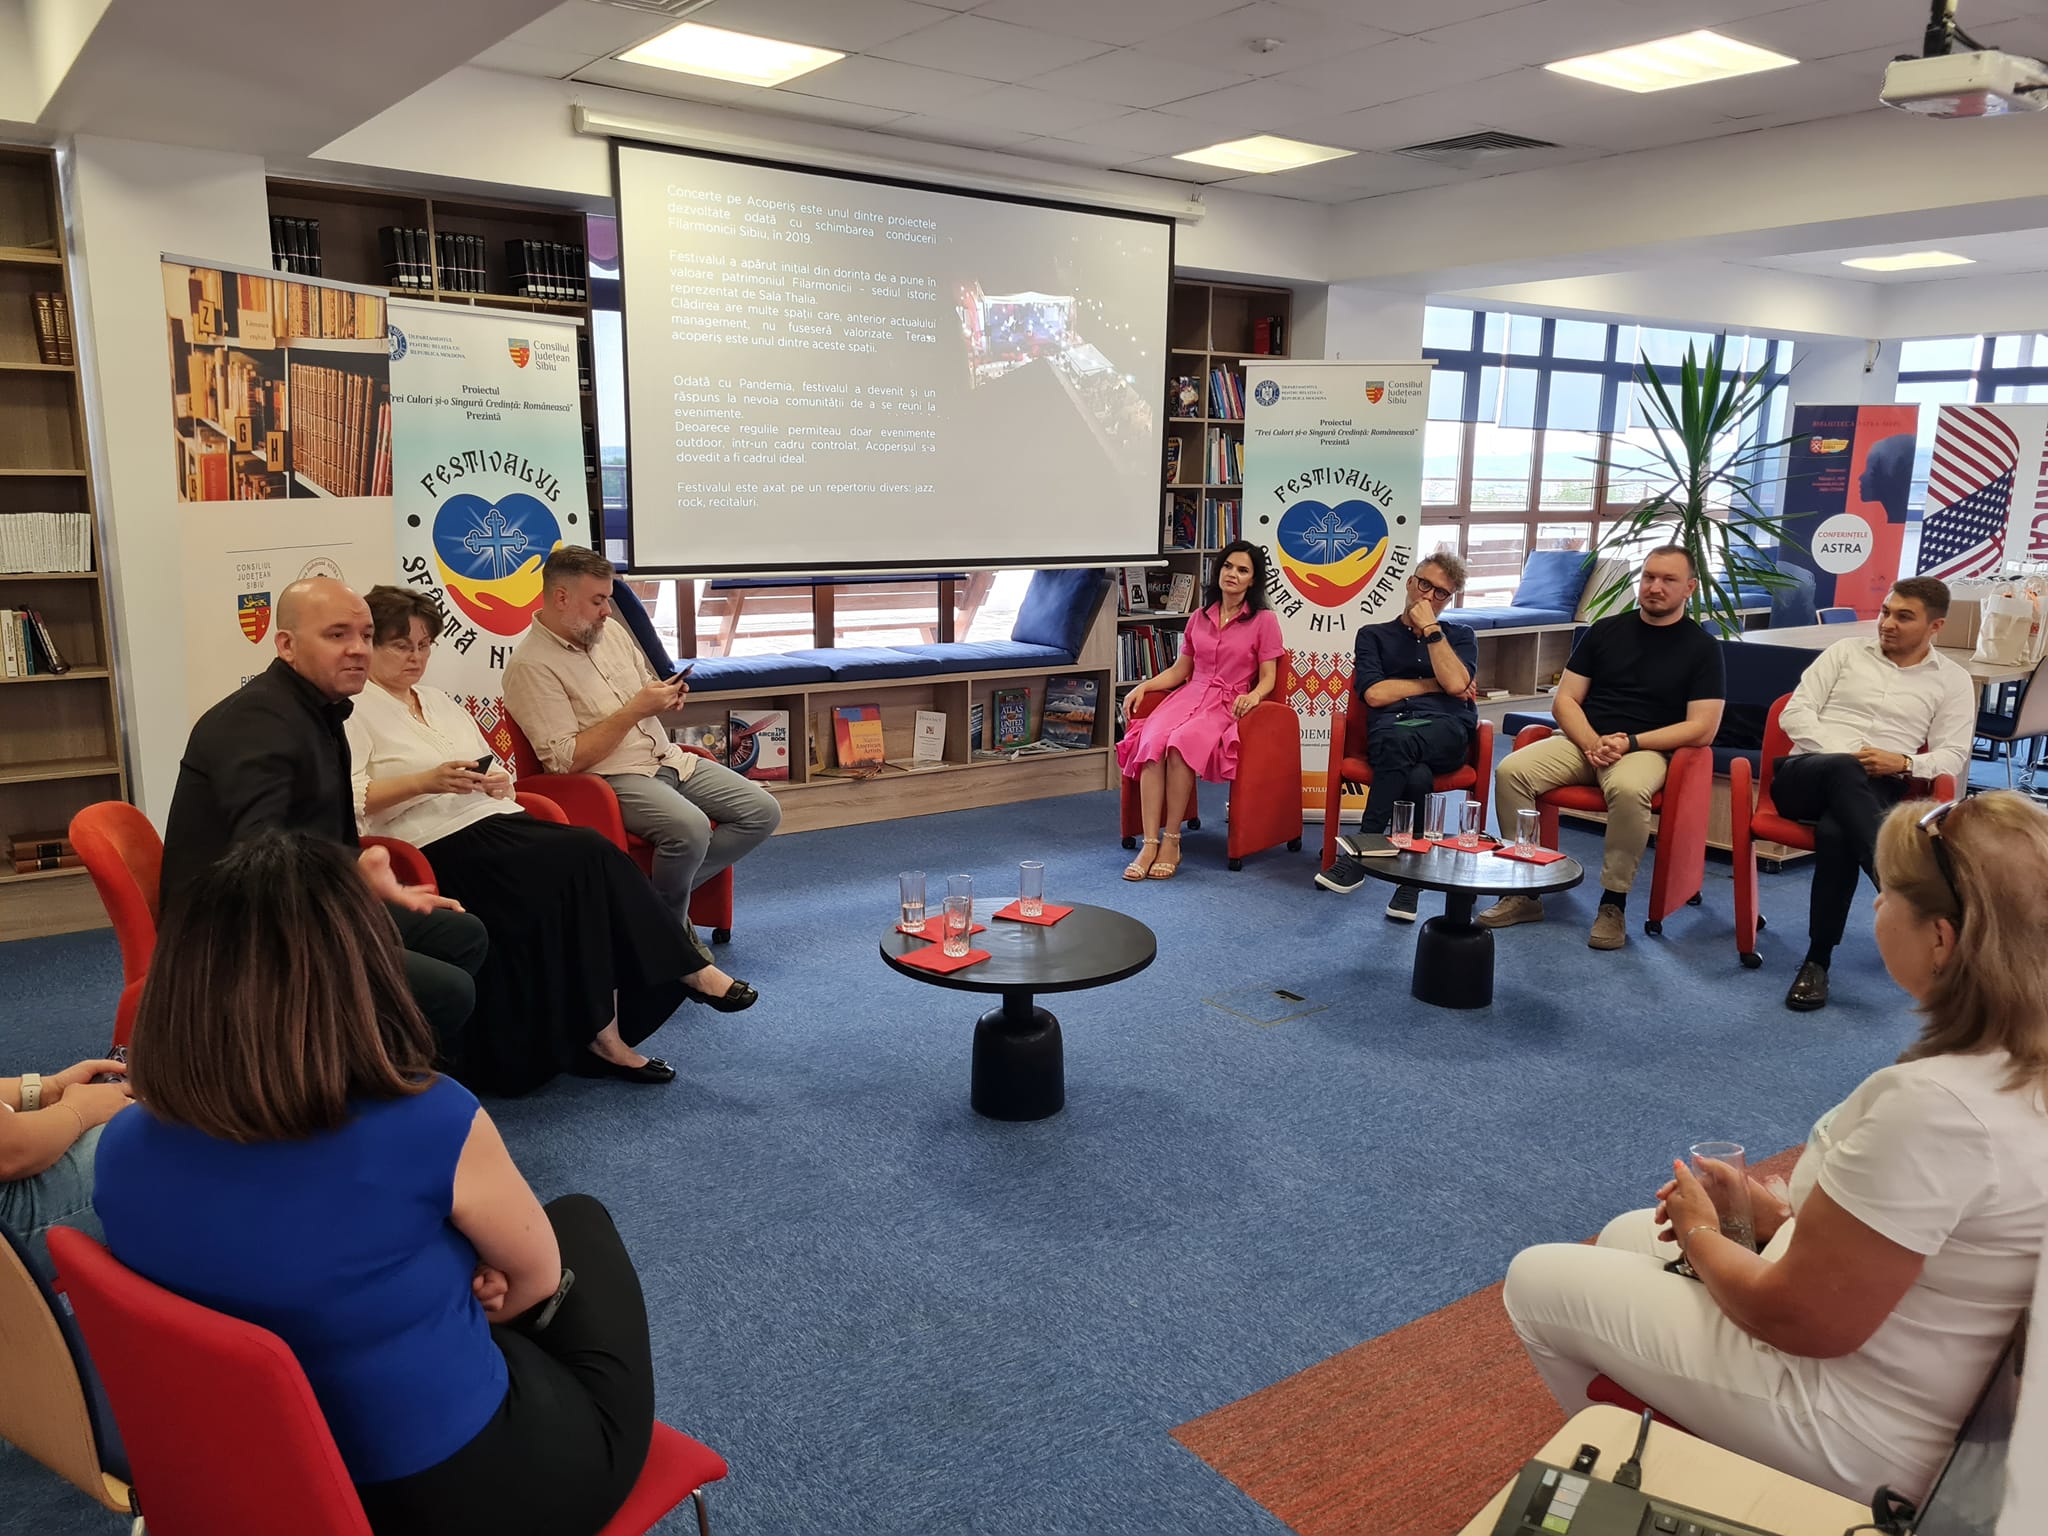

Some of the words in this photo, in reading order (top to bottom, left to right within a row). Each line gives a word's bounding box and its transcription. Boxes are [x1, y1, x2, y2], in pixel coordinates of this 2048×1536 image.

[727, 195, 741, 207] pe
[800, 202, 823, 214] este
[828, 205, 849, 218] unul
[854, 208, 883, 222] dintre
[888, 213, 936, 230] proiectele
[744, 210, 776, 224] odată
[790, 218, 802, 227] cu
[815, 219, 874, 236] schimbarea
[886, 227, 936, 243] conducerii
[739, 225, 769, 241] Sibiu,
[785, 230, 813, 244] 2019.
[669, 250, 725, 266] Festivalul
[730, 259, 737, 267] a
[741, 257, 776, 273] apărut
[814, 265, 830, 276] din
[874, 271, 886, 282] de
[890, 275, 896, 283] a
[900, 276, 924, 287] pune
[670, 266, 714, 280] valoare
[722, 271, 785, 289] patrimoniul
[872, 285, 900, 297] sediul
[907, 288, 936, 300] istoric
[670, 283, 738, 300] reprezentat
[742, 288, 756, 299] de
[759, 289, 781, 301] Sala
[785, 292, 818, 304] Thalia.
[203, 306, 209, 325] Z
[725, 304, 743, 313] are
[748, 303, 779, 316] multe
[847, 311, 886, 324] anterior
[890, 315, 936, 328] actualului
[763, 322, 775, 331] nu
[533, 340, 569, 352] Consiliul
[725, 333, 749, 344] este
[751, 334, 774, 346] unul
[777, 336, 809, 348] dintre
[812, 339, 845, 350] aceste
[536, 360, 557, 371] Sibiu
[462, 385, 500, 395] Proiectul
[673, 375, 710, 387] Odată
[718, 380, 732, 388] cu
[740, 378, 794, 393] Pandemia,
[803, 381, 848, 393] festivalul
[855, 386, 861, 394] a
[868, 384, 903, 396] devenit
[924, 389, 936, 397] un
[1388, 380, 1423, 388] Consiliul
[406, 395, 433, 404] Culori
[450, 397, 483, 409] Singură
[674, 391, 720, 405] răspuns
[727, 393, 737, 403] la
[744, 394, 779, 405] nevoia
[850, 398, 863, 408] de
[869, 401, 875, 409] a
[898, 400, 922, 410] reuni
[928, 401, 935, 411] la
[1388, 396, 1407, 404] Sibiu
[466, 411, 501, 421] Prezintă
[674, 408, 744, 419] evenimente.
[239, 423, 247, 443] G
[675, 421, 730, 433] Deoarece
[740, 423, 779, 436] regulile
[788, 424, 841, 438] permiteau
[850, 426, 872, 436] doar
[881, 427, 936, 438] evenimente
[774, 438, 804, 449] cadru
[271, 438, 278, 462] H
[676, 451, 720, 462] dovedit
[723, 454, 730, 462] a
[733, 452, 740, 462] fi
[743, 452, 776, 463] cadrul
[677, 482, 730, 492] Festivalul
[736, 483, 758, 492] este
[763, 483, 785, 492] axat
[791, 485, 804, 494] pe
[826, 483, 875, 494] repertoriu
[678, 496, 705, 509] rock,
[1820, 543, 1862, 553] ASTRA
[236, 562, 271, 572] CONSILIUL
[246, 581, 265, 590] SIBIU
[1001, 705, 1024, 714] ATLAS
[1000, 727, 1024, 735] STATES
